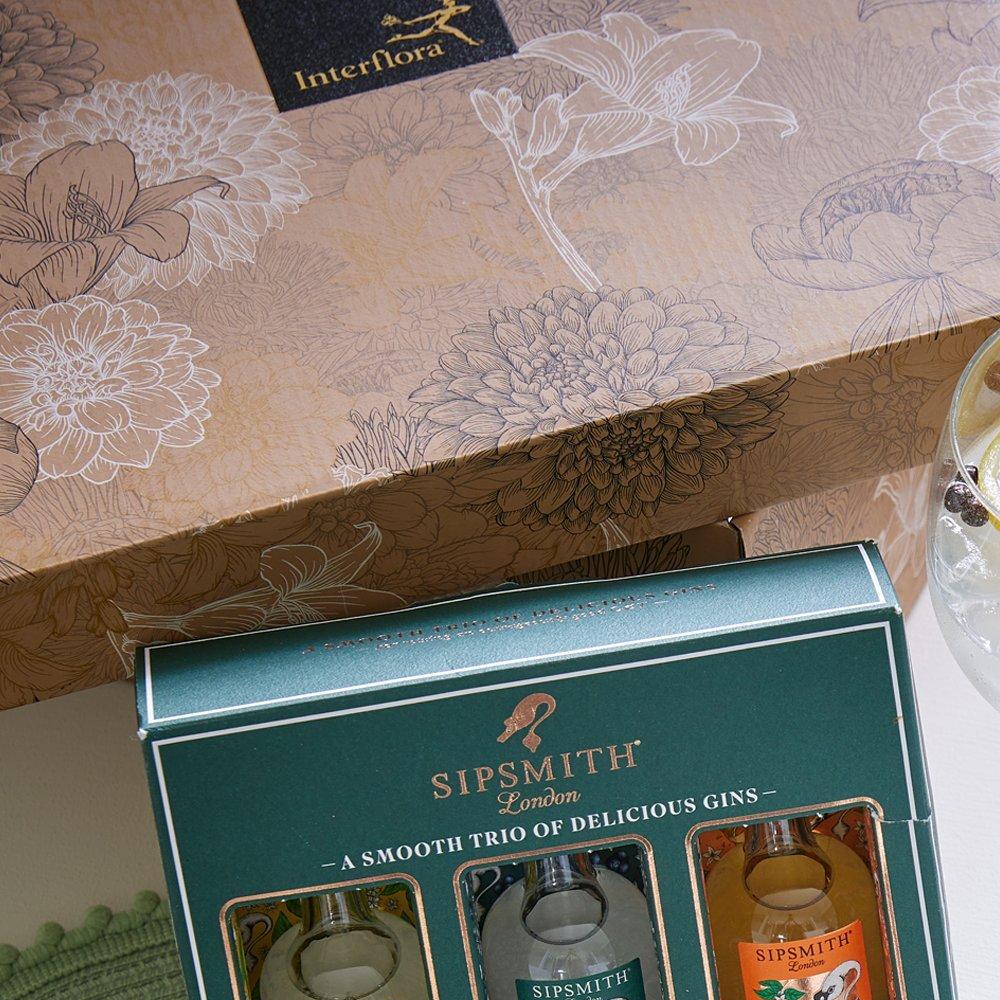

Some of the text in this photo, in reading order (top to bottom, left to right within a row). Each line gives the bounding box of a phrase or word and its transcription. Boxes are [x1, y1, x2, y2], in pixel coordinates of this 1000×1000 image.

[294, 42, 445, 91] Interflora
[431, 741, 639, 800] SIPSMITH
[497, 786, 582, 816] London
[362, 836, 463, 868] SMOOTH
[469, 826, 527, 849] TRIO
[533, 819, 564, 838] OF
[571, 797, 697, 833] DELICIOUS
[703, 787, 759, 811] GINS
[756, 931, 851, 962] SIPSMITH
[788, 958, 825, 973] London
[533, 969, 630, 999] SIPSMITH
